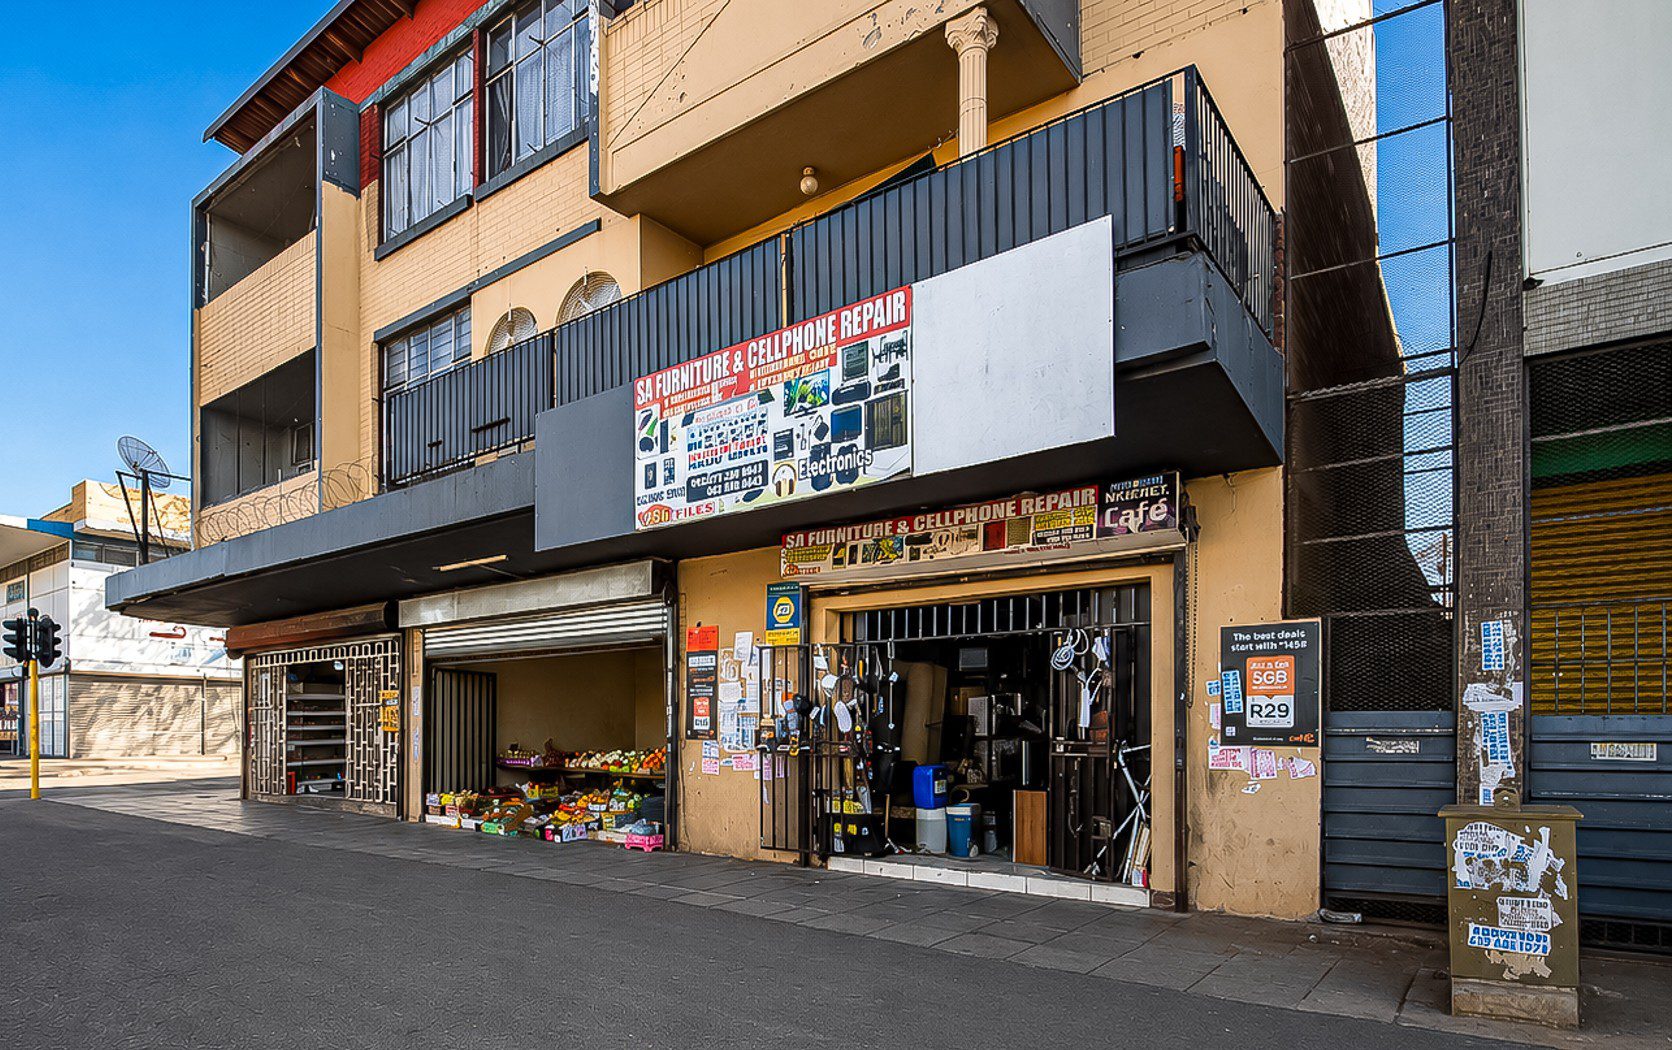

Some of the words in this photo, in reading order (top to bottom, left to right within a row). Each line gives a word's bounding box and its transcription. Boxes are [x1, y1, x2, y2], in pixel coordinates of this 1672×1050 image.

[637, 378, 653, 405] SA
[655, 350, 730, 399] FURNITURE
[733, 350, 744, 374] &
[747, 314, 837, 369] CELLPHONE
[840, 290, 906, 340] REPAIR
[798, 449, 873, 479] Electronics
[675, 501, 715, 519] FILES
[785, 534, 804, 549] SA
[807, 522, 893, 547] FURNITURE
[896, 520, 909, 534] &
[913, 500, 1016, 531] CELLPHONE
[1021, 487, 1096, 515] REPAIR
[1233, 633, 1251, 641] The
[1253, 631, 1275, 640] best
[1277, 629, 1306, 639] deals
[1230, 642, 1253, 652] start
[1255, 641, 1278, 651] with
[1250, 703, 1290, 719] R29
